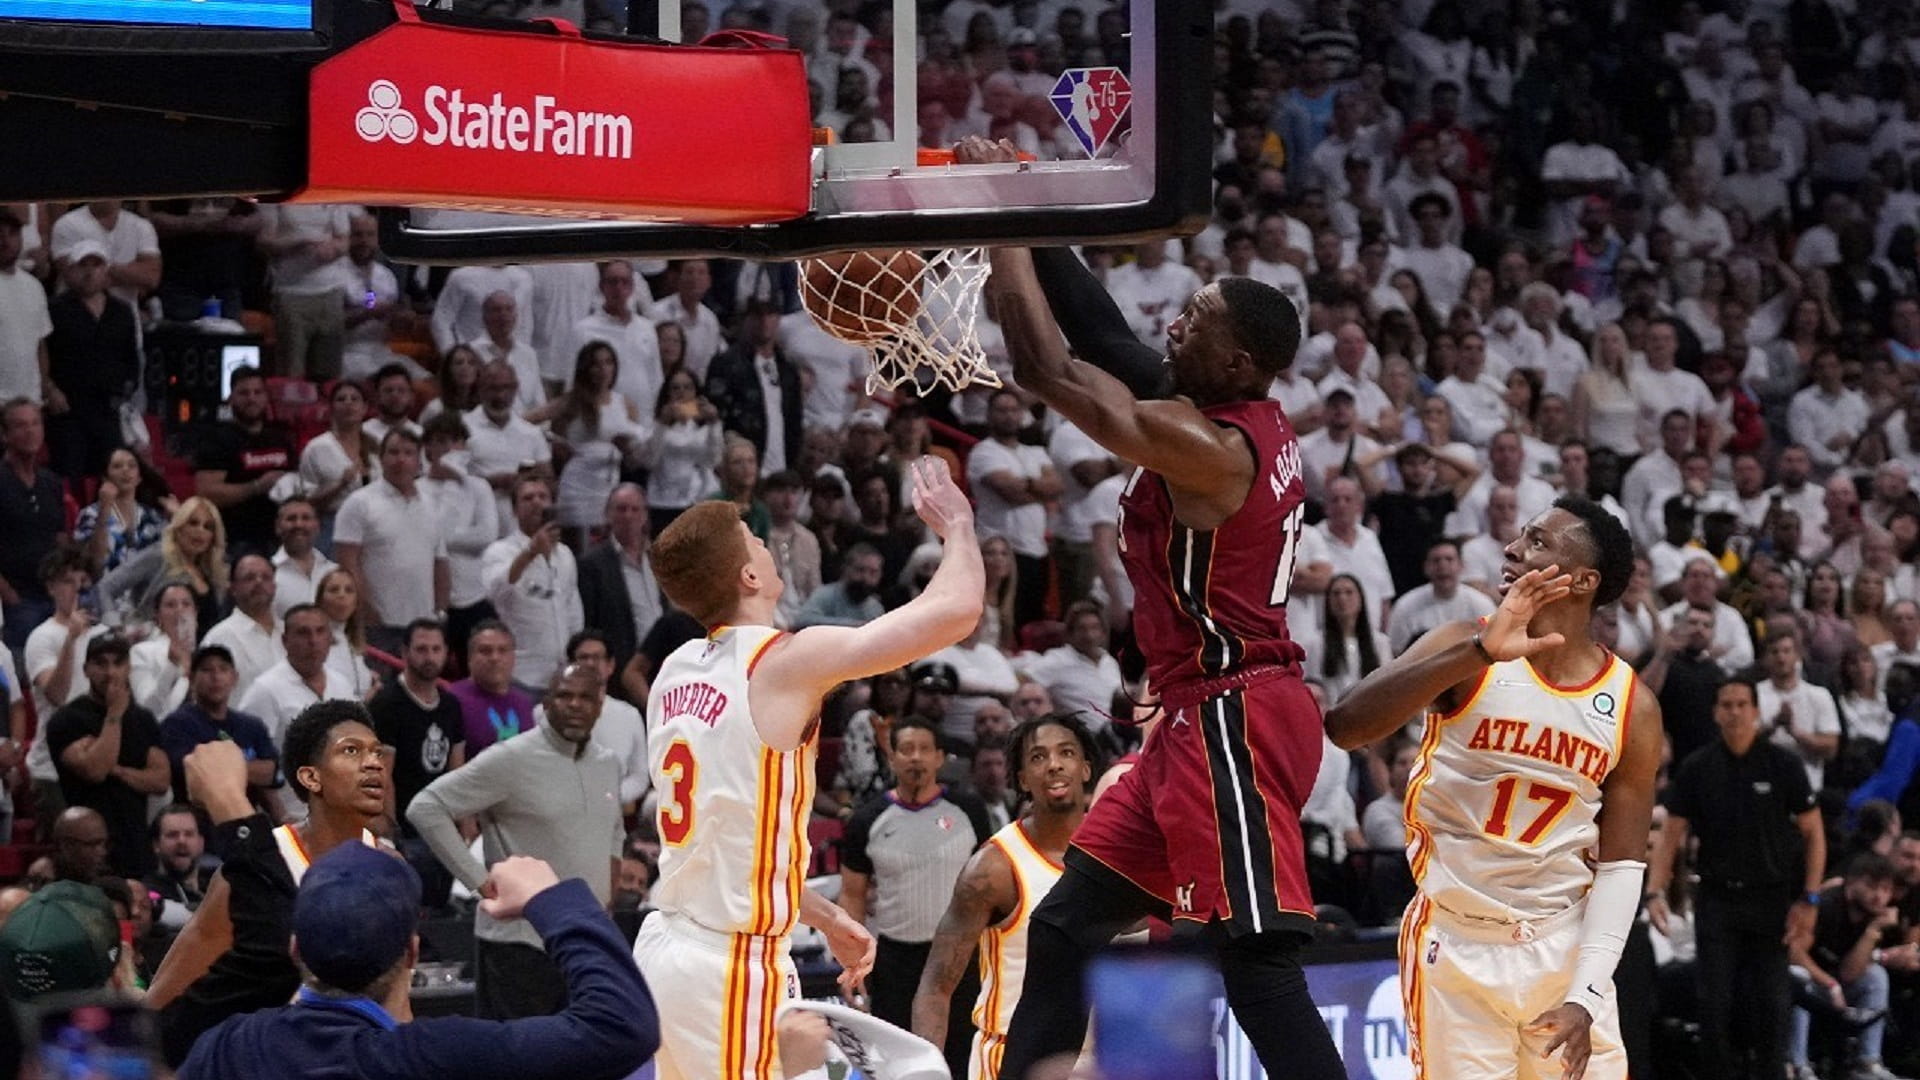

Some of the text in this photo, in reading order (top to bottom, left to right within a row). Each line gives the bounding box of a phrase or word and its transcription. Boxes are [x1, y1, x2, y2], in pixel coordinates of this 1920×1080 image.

[1100, 81, 1116, 107] 75
[662, 682, 728, 729] HUERTER
[1468, 718, 1610, 785] ATLANTA
[660, 740, 697, 845] 3
[1484, 776, 1574, 844] 17
[1363, 1017, 1408, 1059] TN
